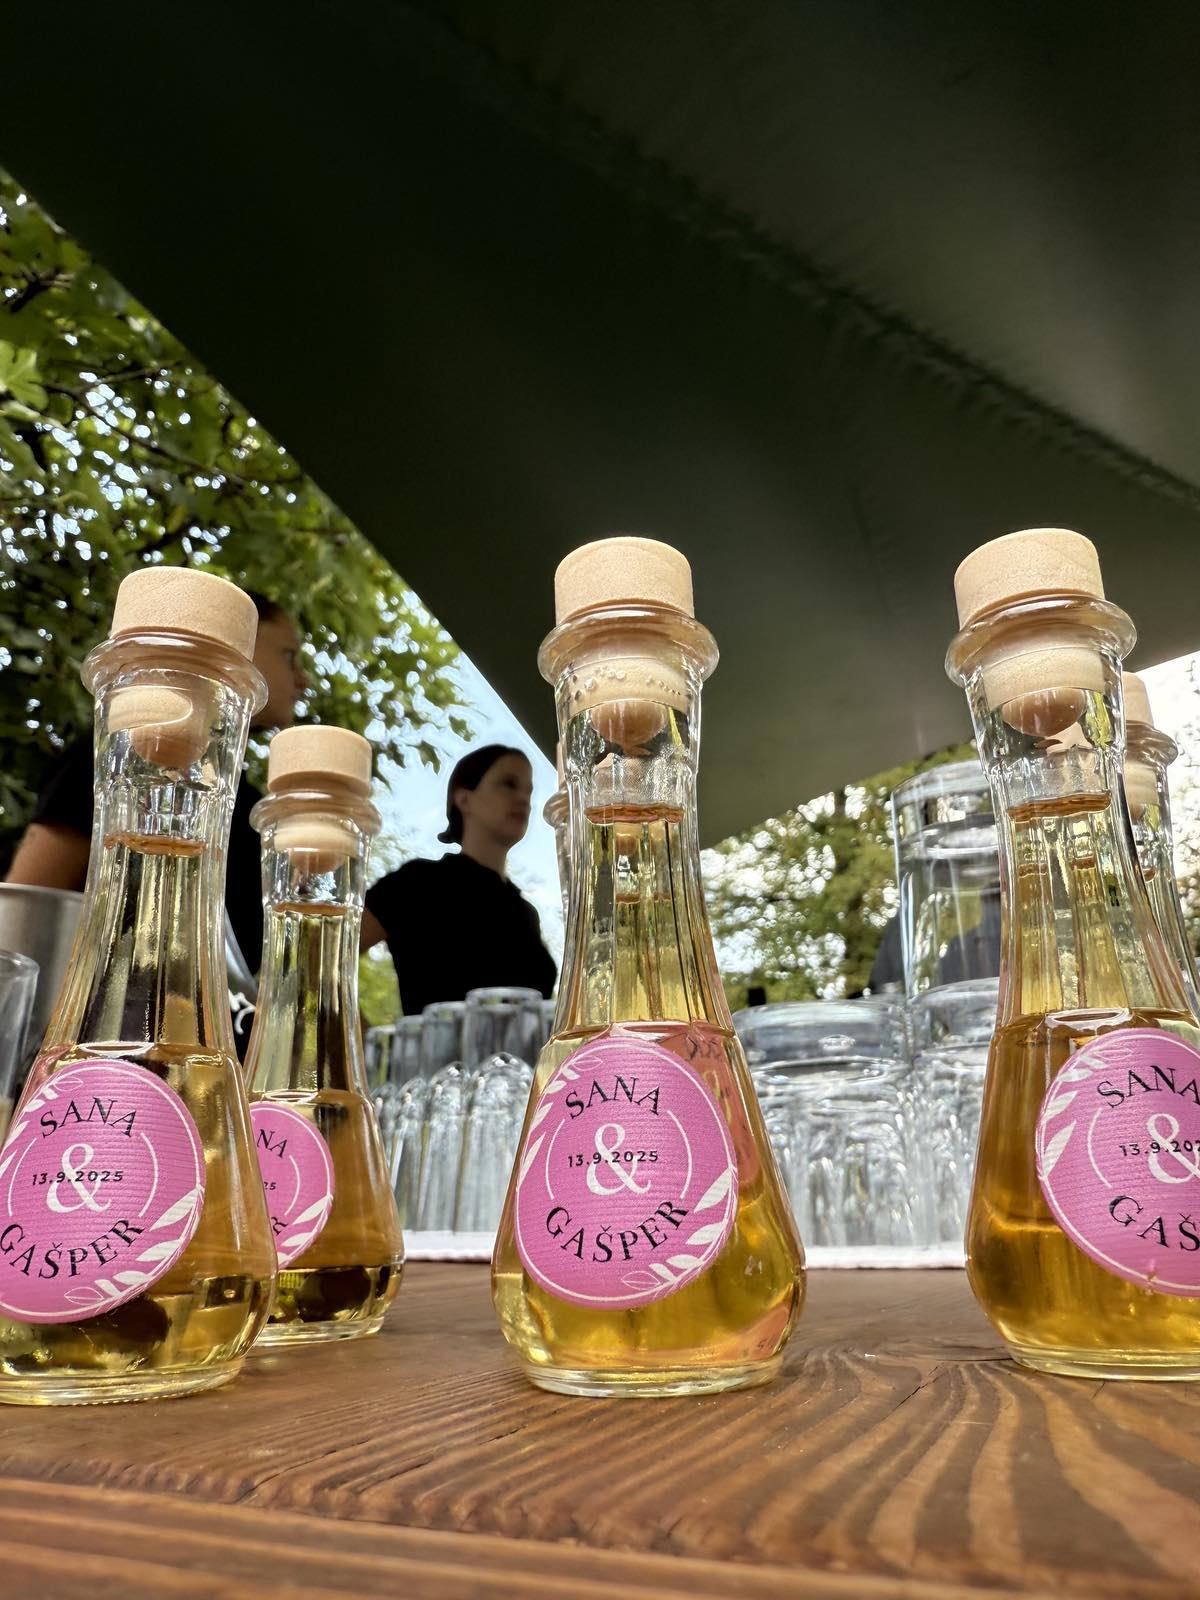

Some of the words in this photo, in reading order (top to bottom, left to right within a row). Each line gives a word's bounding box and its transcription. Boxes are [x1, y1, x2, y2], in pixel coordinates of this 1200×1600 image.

[565, 1074, 662, 1120] SANA
[1096, 1065, 1200, 1108] SANA
[40, 1096, 137, 1139] SANA
[256, 1128, 288, 1160] NA
[568, 1150, 659, 1168] 13.9.2025
[586, 1123, 651, 1196] &
[32, 1170, 124, 1186] 13.9.2025
[46, 1143, 112, 1214] &
[545, 1201, 690, 1263] GAŠPER
[1108, 1195, 1200, 1252] GAŠ
[0, 1219, 145, 1280] GAŠPER
